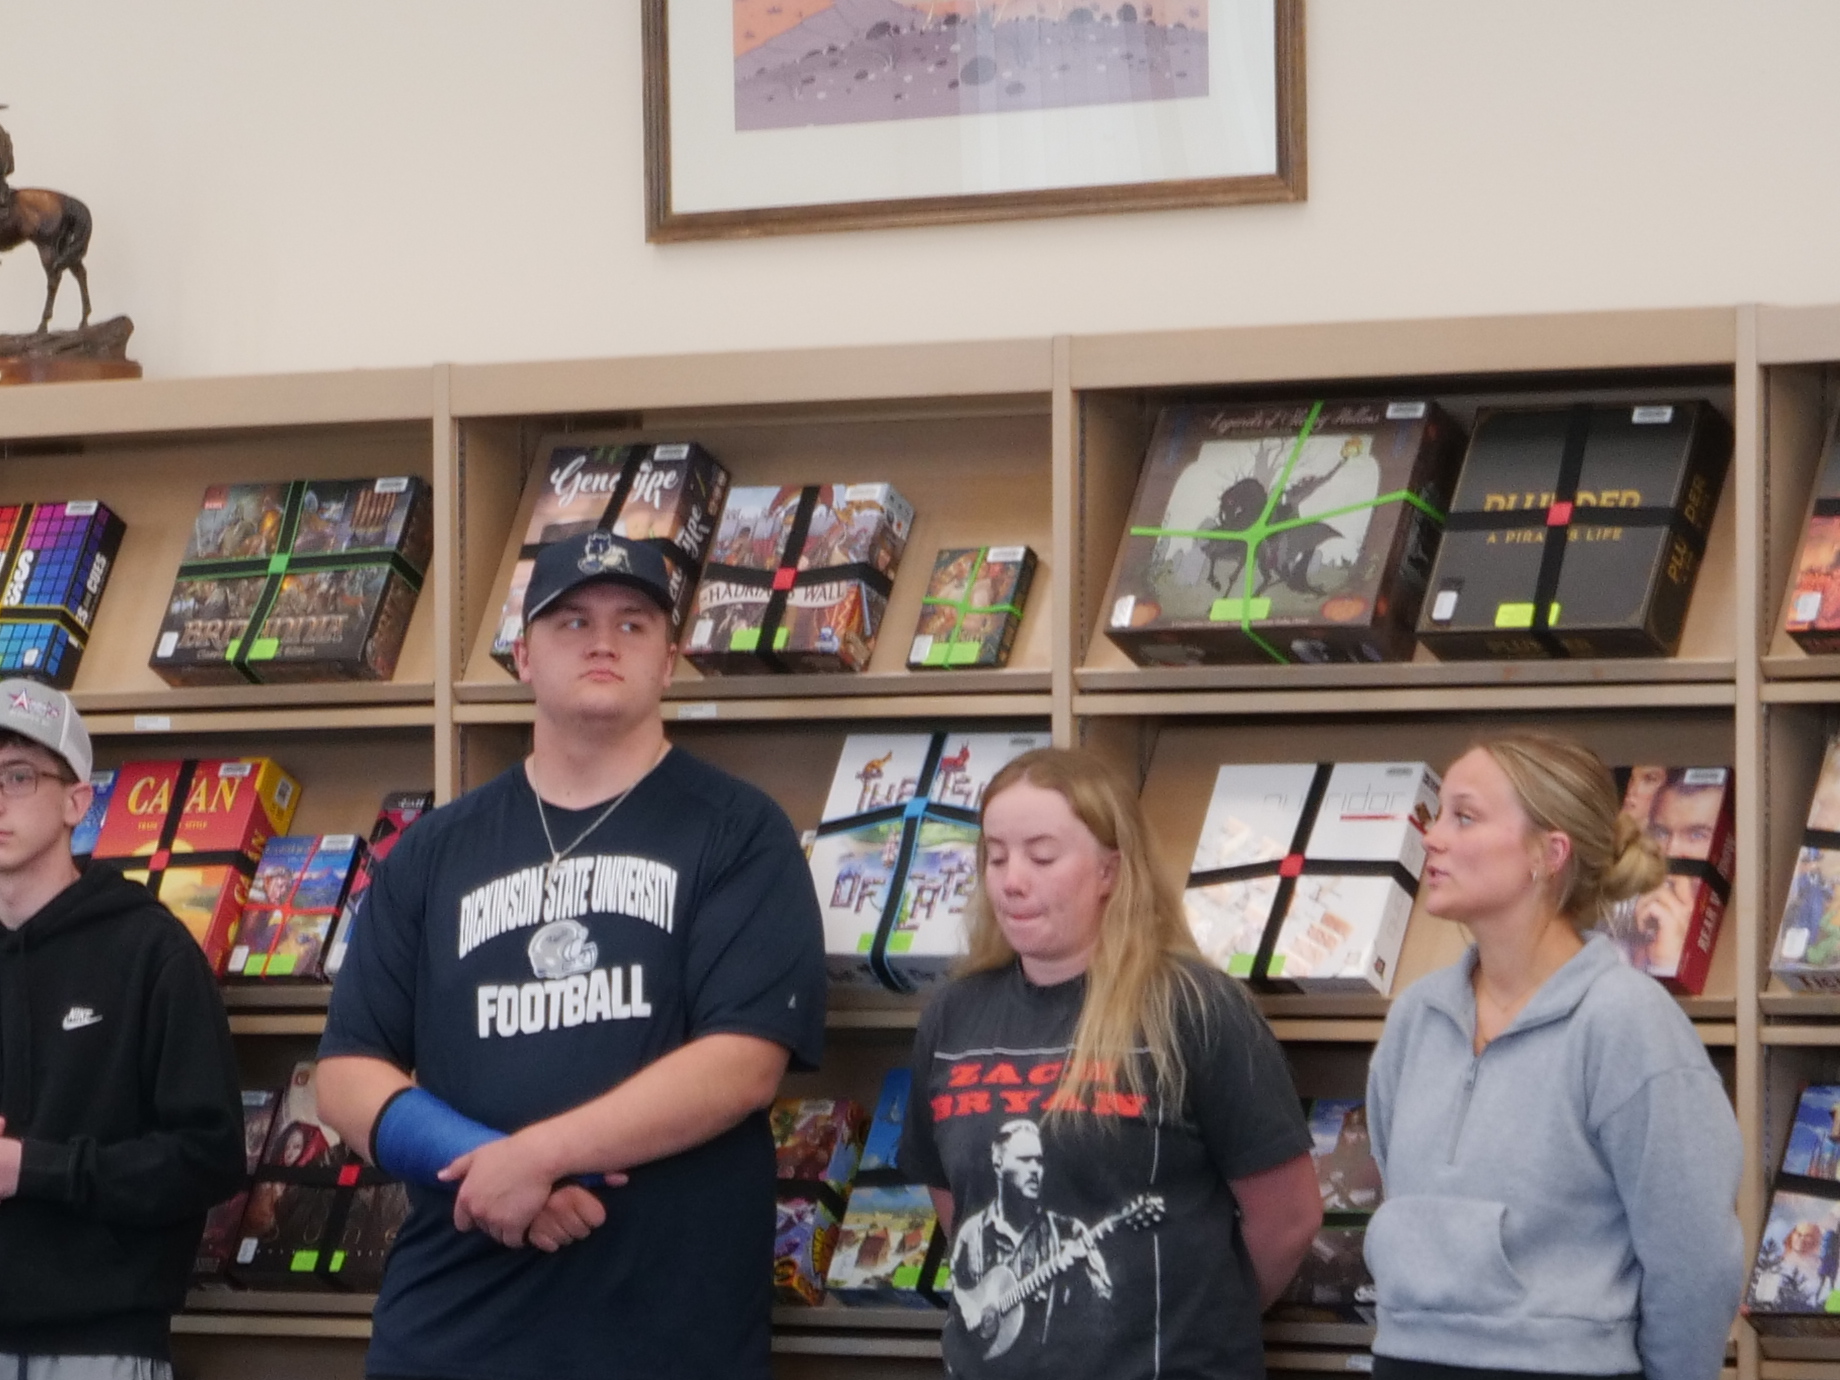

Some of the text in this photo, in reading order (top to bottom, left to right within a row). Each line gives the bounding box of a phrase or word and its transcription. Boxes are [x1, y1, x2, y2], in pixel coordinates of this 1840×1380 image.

[804, 581, 846, 602] WALL
[127, 775, 244, 816] CAAN
[458, 854, 678, 961] DICKINSON STATE UNIVERSITY
[477, 964, 652, 1039] FOOTBALL
